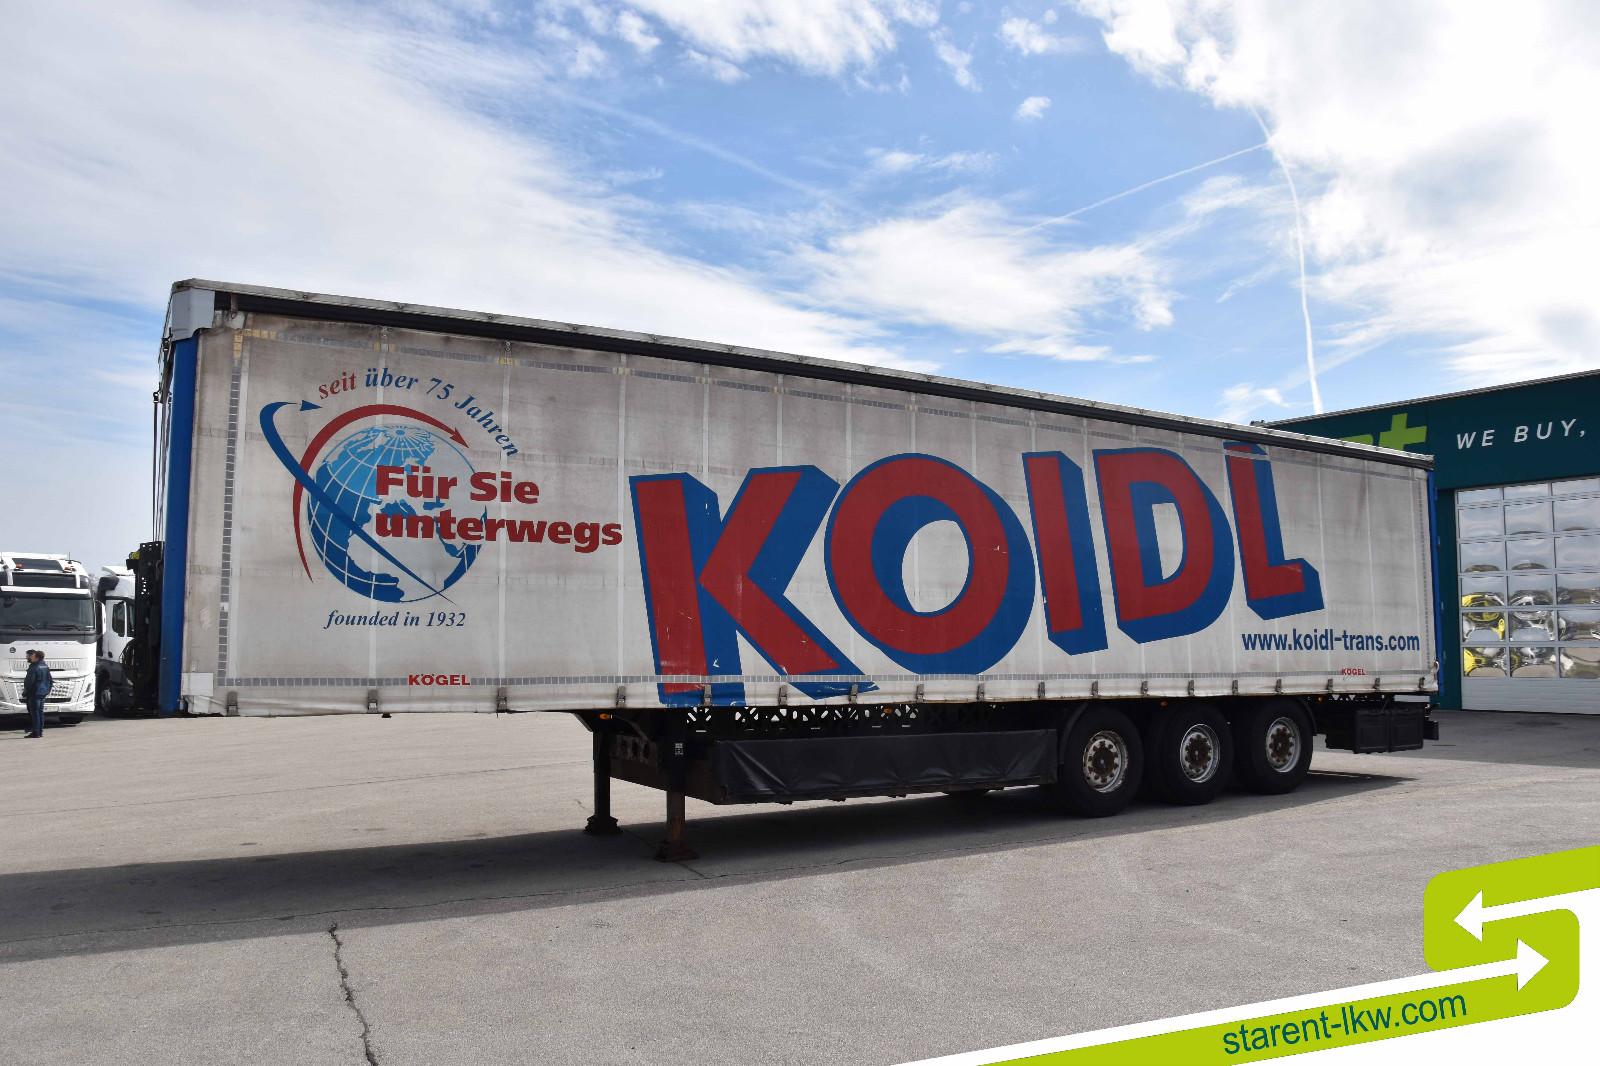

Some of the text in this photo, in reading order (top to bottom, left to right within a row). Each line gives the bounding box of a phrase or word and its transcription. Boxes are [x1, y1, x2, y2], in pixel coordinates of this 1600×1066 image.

[318, 367, 519, 457] seit über 75 Jahren
[1456, 418, 1586, 450] WE BUY,
[376, 465, 540, 504] Für Sie
[375, 508, 623, 553] unterwegs
[629, 442, 1324, 707] KOIDL
[323, 610, 466, 629] founded in 1932
[1242, 628, 1420, 651] www.koidl-trans.com
[408, 673, 471, 686] KÖGEL
